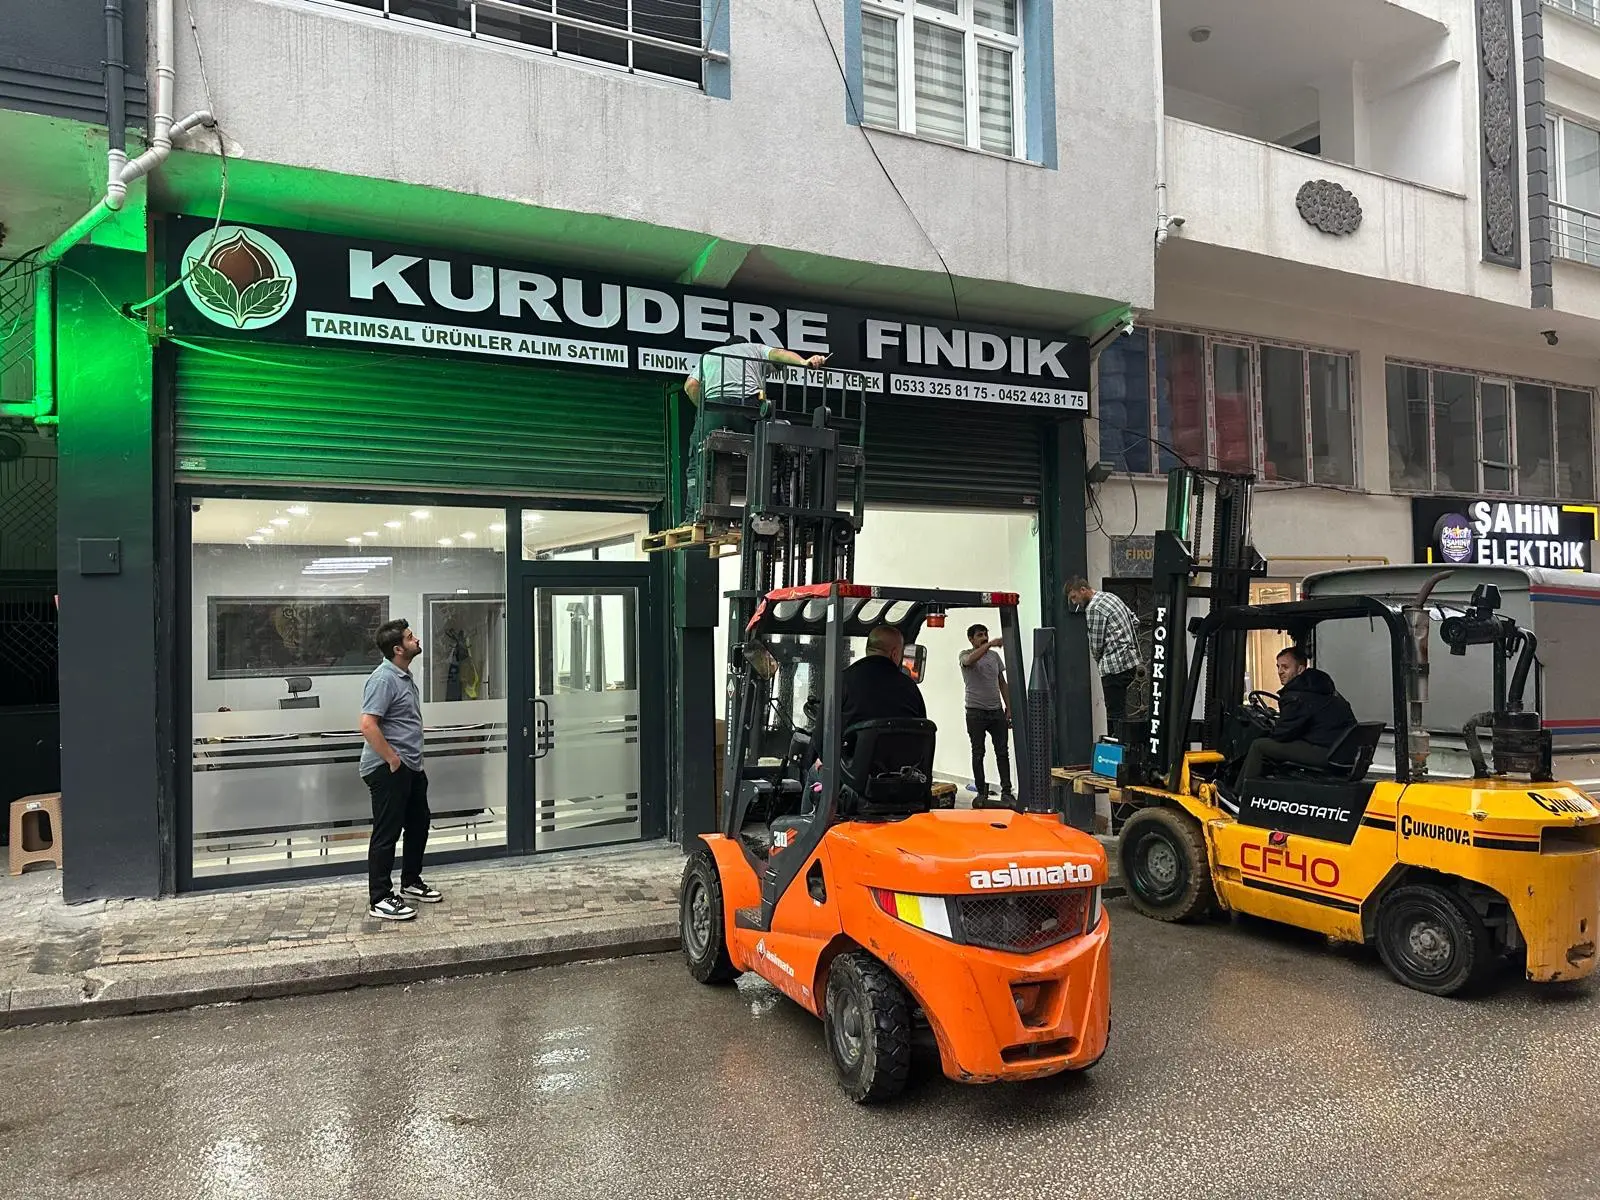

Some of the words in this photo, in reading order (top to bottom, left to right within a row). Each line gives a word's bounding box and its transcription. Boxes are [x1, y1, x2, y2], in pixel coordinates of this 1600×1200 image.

[349, 248, 830, 354] KURUDERE
[866, 318, 1070, 379] FINDIK
[311, 317, 415, 342] TARIMSAL
[421, 325, 512, 352] ÜRÜNLER
[518, 339, 561, 357] ALIM
[567, 344, 624, 363] SATIMI
[642, 352, 689, 371] FINDIK
[894, 378, 925, 394] 0533
[929, 382, 951, 396] 325
[955, 385, 969, 398] 81
[974, 387, 988, 399] 75
[999, 388, 1027, 403] 0452
[1030, 391, 1051, 404] 423
[1054, 394, 1067, 405] 81
[1070, 394, 1084, 407] 75
[1477, 539, 1585, 567] ELEKTRIK
[773, 830, 788, 848] 30
[1401, 814, 1471, 846] ÇUKUROVA
[969, 862, 1093, 889] asimato
[1240, 842, 1340, 888] CF40
